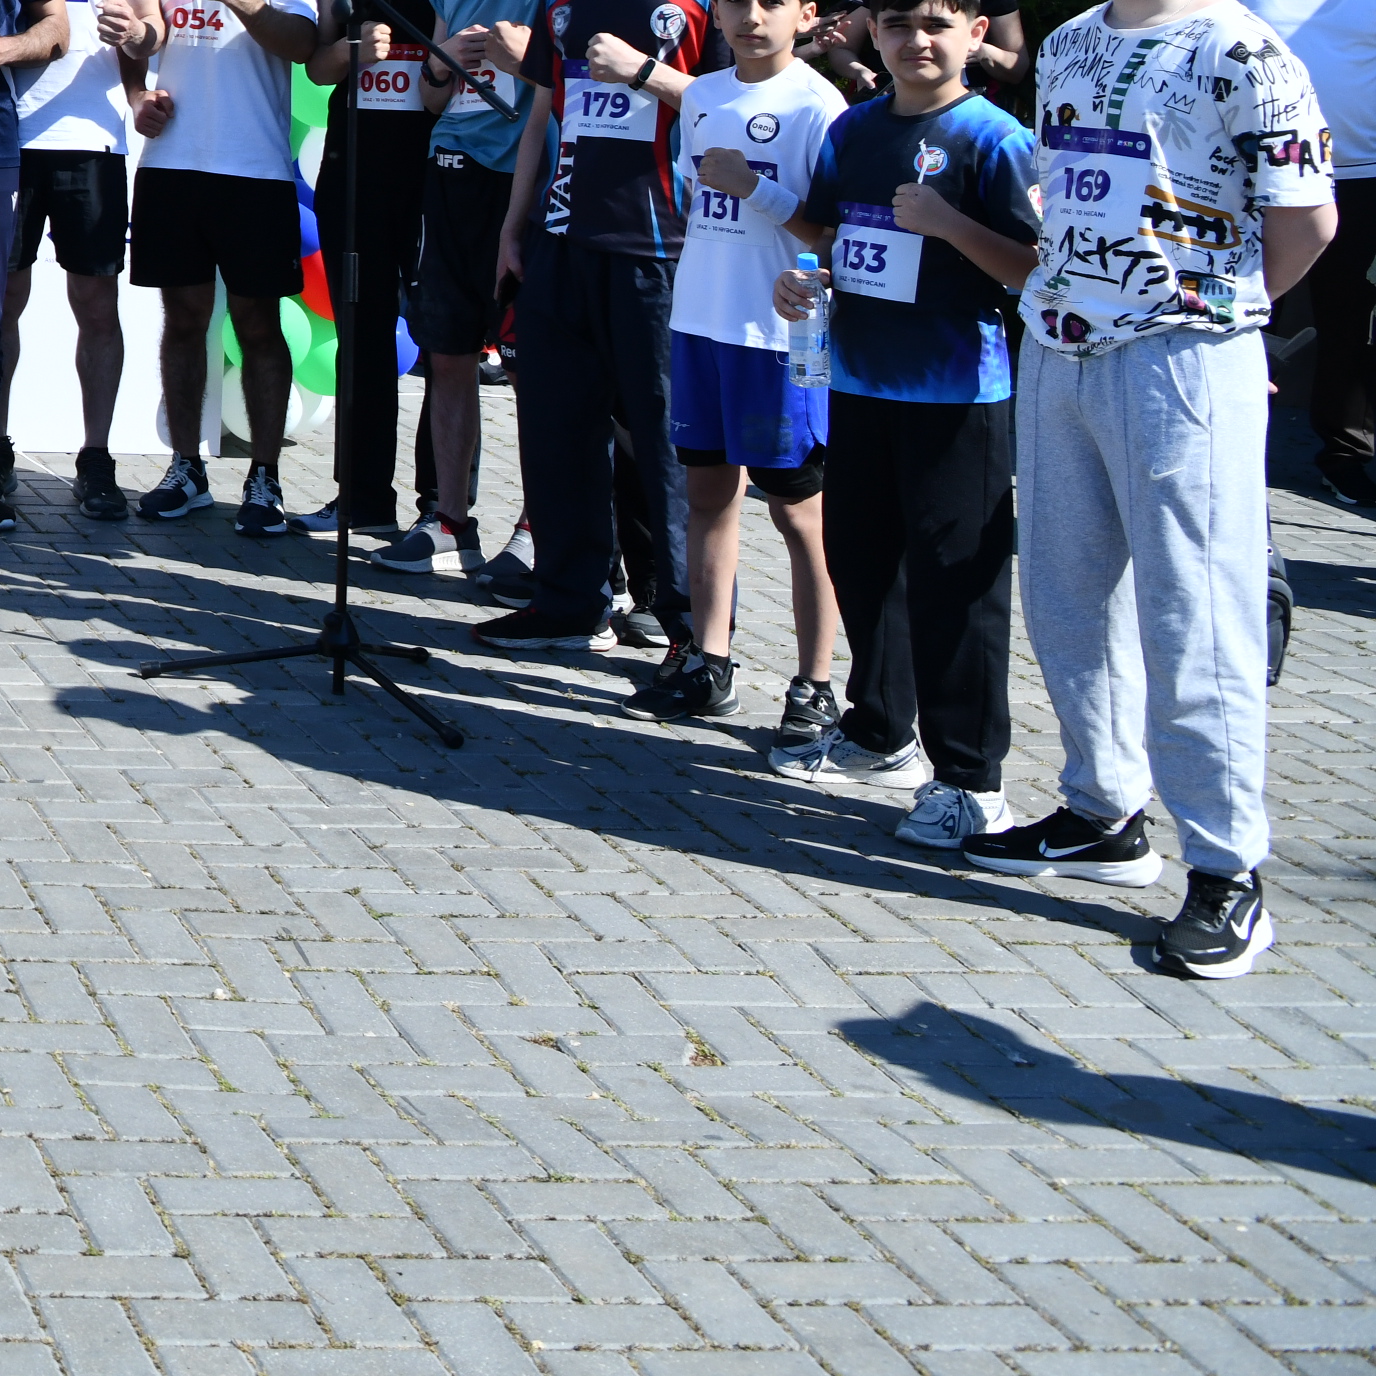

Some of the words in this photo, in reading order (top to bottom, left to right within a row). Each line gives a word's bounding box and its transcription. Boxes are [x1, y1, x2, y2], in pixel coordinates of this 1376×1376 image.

[172, 7, 224, 31] 054
[360, 70, 410, 93] 060
[581, 91, 630, 118] 179
[752, 122, 775, 133] ORDU
[436, 153, 464, 169] UFC
[1064, 167, 1112, 202] 169
[701, 190, 740, 222] 131
[842, 238, 888, 274] 133
